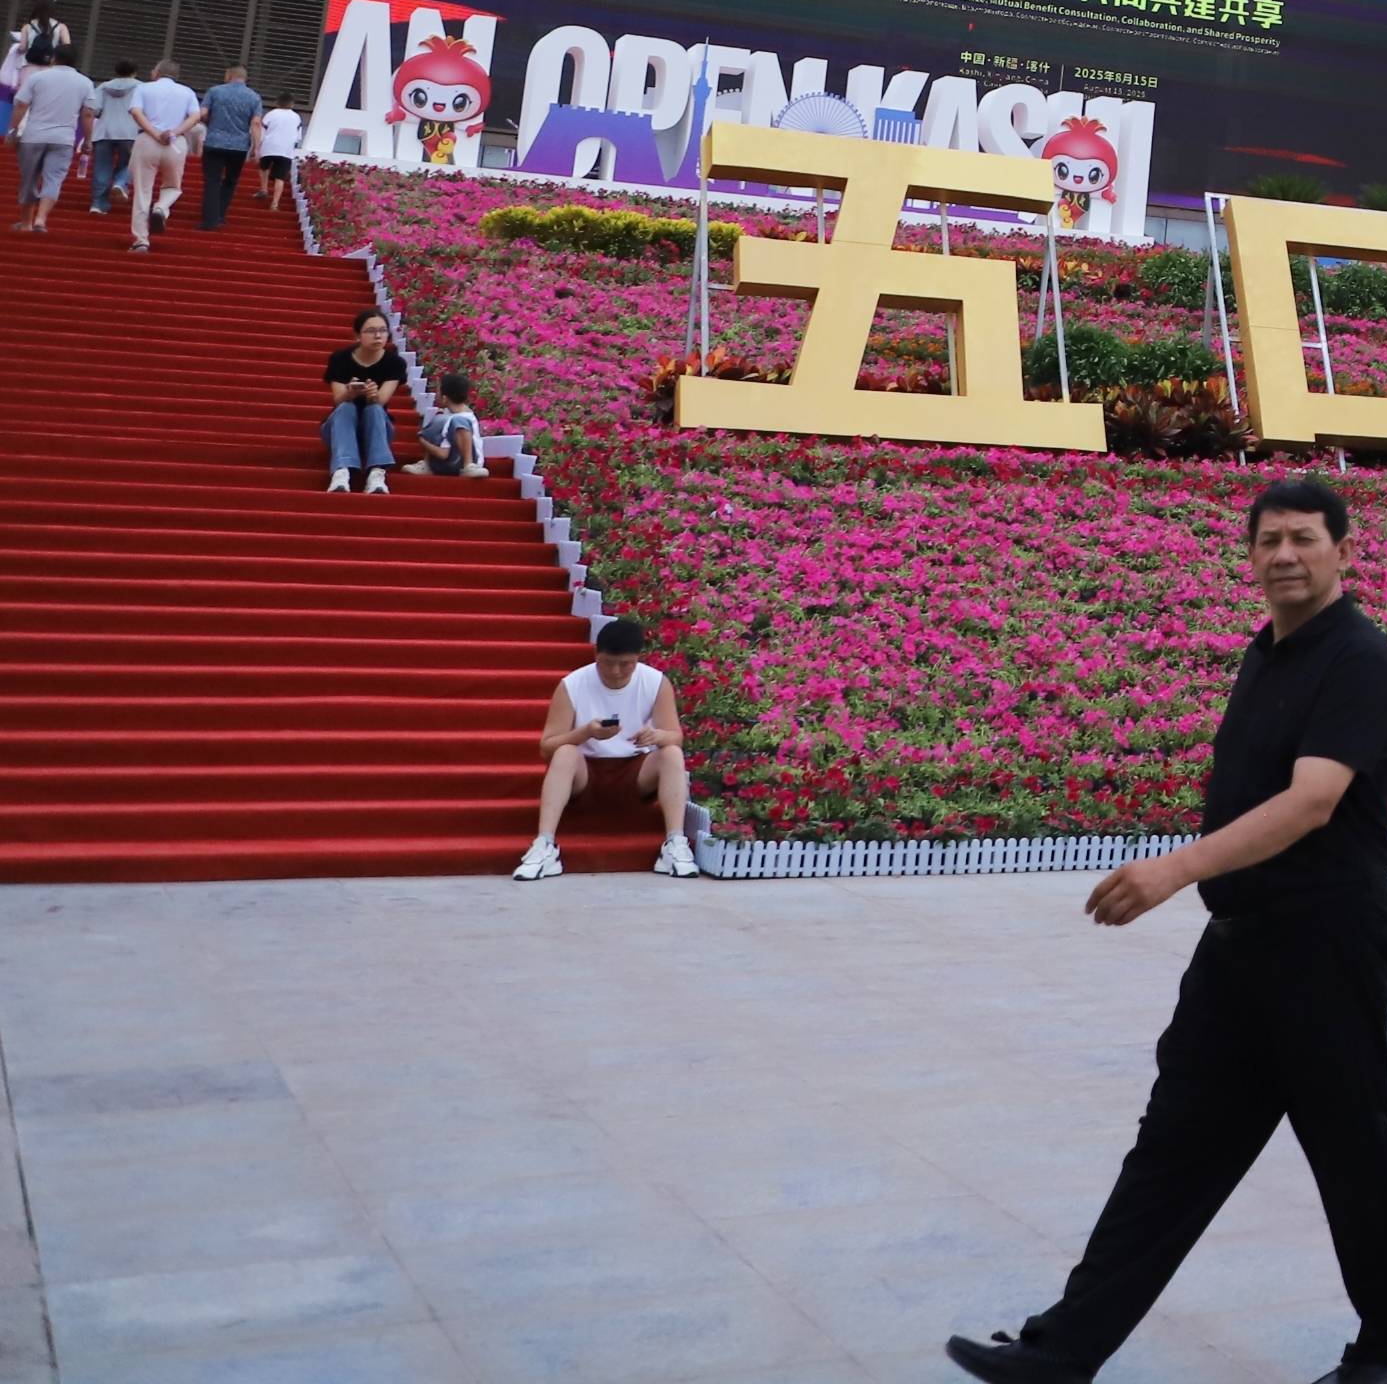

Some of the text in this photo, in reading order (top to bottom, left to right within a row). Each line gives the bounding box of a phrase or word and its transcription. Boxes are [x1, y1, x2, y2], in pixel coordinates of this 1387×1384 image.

[1023, 1, 1058, 15] Benefit
[1186, 26, 1203, 36] and
[1203, 27, 1235, 40] Shared
[1235, 32, 1281, 48] Prosperity
[1074, 67, 1159, 89] 2025年8月15日
